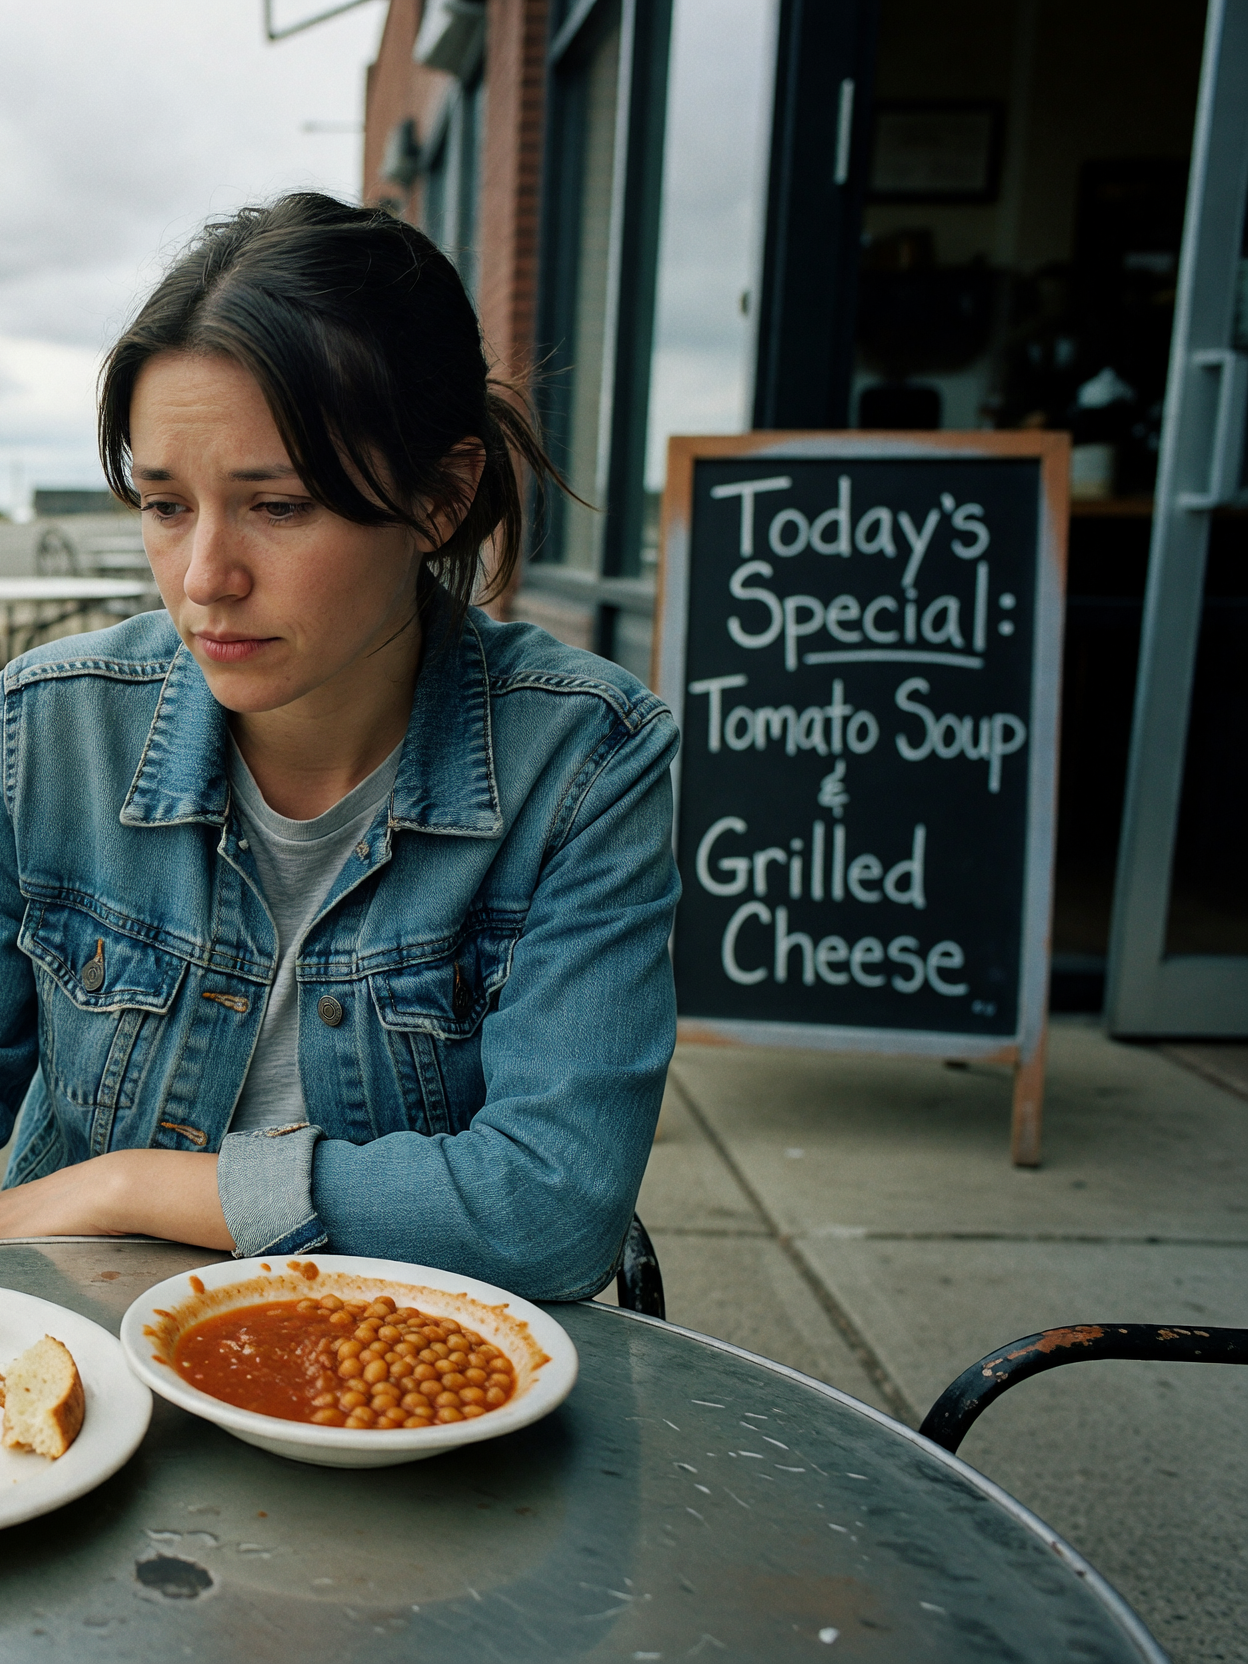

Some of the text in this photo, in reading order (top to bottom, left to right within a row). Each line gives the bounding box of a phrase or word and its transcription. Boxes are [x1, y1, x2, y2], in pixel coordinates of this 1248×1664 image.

[709, 475, 991, 590] Today's
[726, 560, 1017, 672] Special:
[689, 673, 1028, 793] Tomato Soup
[817, 758, 850, 819] &
[695, 815, 927, 910] Grilled
[721, 900, 970, 997] Cheese
